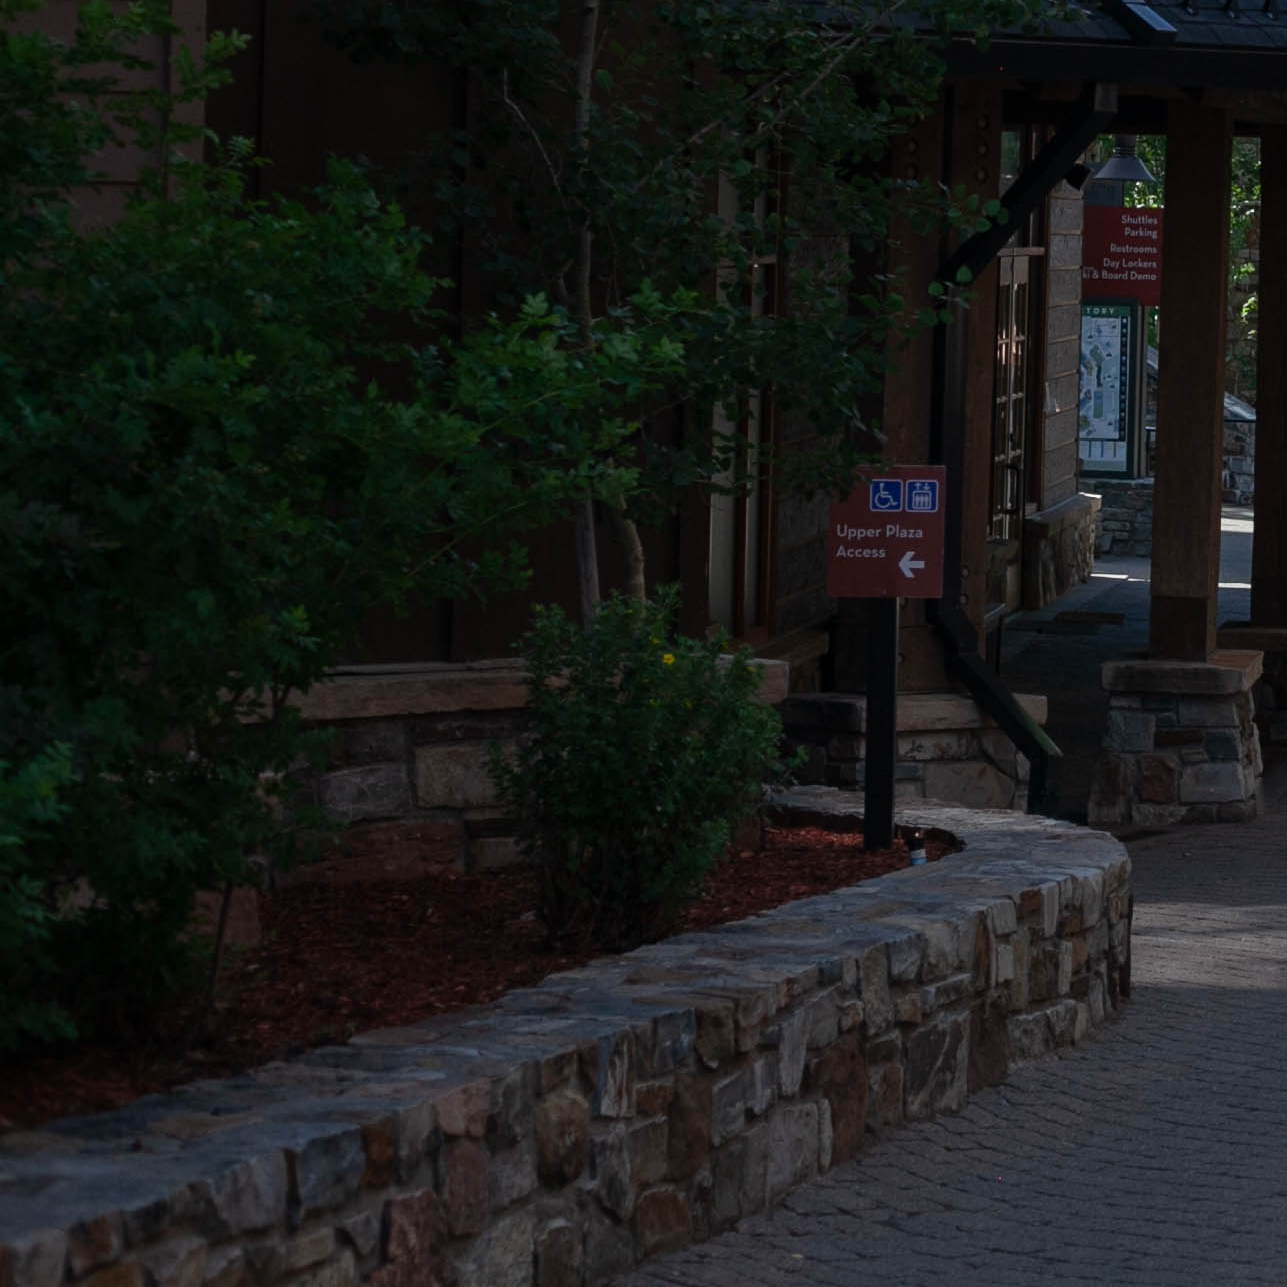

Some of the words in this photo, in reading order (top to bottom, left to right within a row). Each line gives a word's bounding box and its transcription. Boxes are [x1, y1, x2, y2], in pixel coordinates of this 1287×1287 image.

[1121, 215, 1158, 225] Shuttles
[1124, 227, 1158, 240] Parking
[1110, 243, 1158, 254] Restrooms
[1103, 257, 1120, 269] Day
[1122, 258, 1158, 269] Lockers
[1092, 270, 1098, 279] &
[1102, 271, 1128, 280] Board
[1130, 271, 1157, 281] Demo
[836, 524, 882, 541] Upper
[886, 524, 923, 538] Plaza
[836, 545, 886, 558] Access
